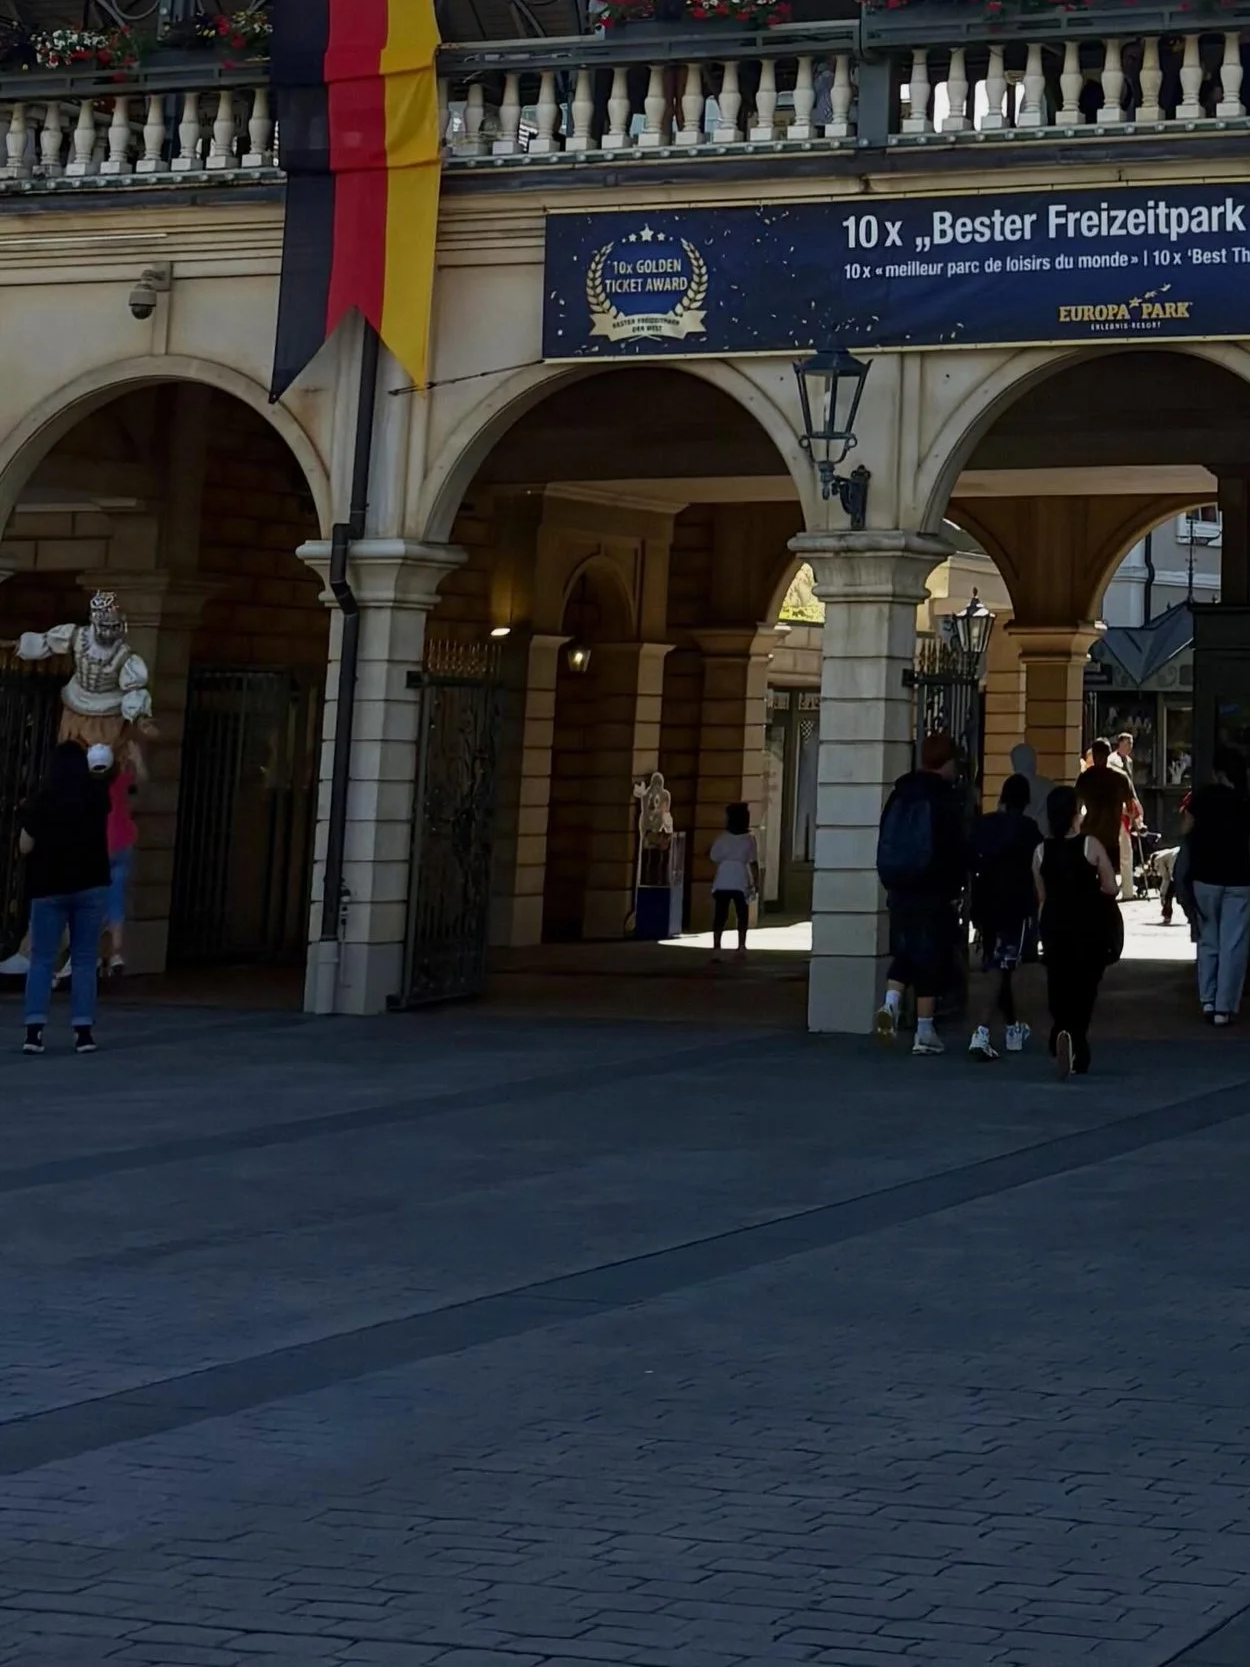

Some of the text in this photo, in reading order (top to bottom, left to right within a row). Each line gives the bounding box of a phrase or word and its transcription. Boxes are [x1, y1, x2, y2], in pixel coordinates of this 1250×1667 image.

[842, 214, 878, 248] 10
[884, 220, 903, 247] x
[915, 209, 1037, 252] „Bester
[1048, 198, 1247, 242] Freizeitpark
[612, 258, 681, 274] 10x GOLDEN
[844, 263, 860, 279] 10
[947, 261, 979, 278] parc
[984, 257, 1002, 272] de
[1006, 254, 1050, 272] loisirs
[1055, 253, 1073, 269] du
[1153, 250, 1170, 265] 10
[605, 277, 688, 293] TICKET AWARD
[1059, 302, 1190, 322] EUROPA PARK
